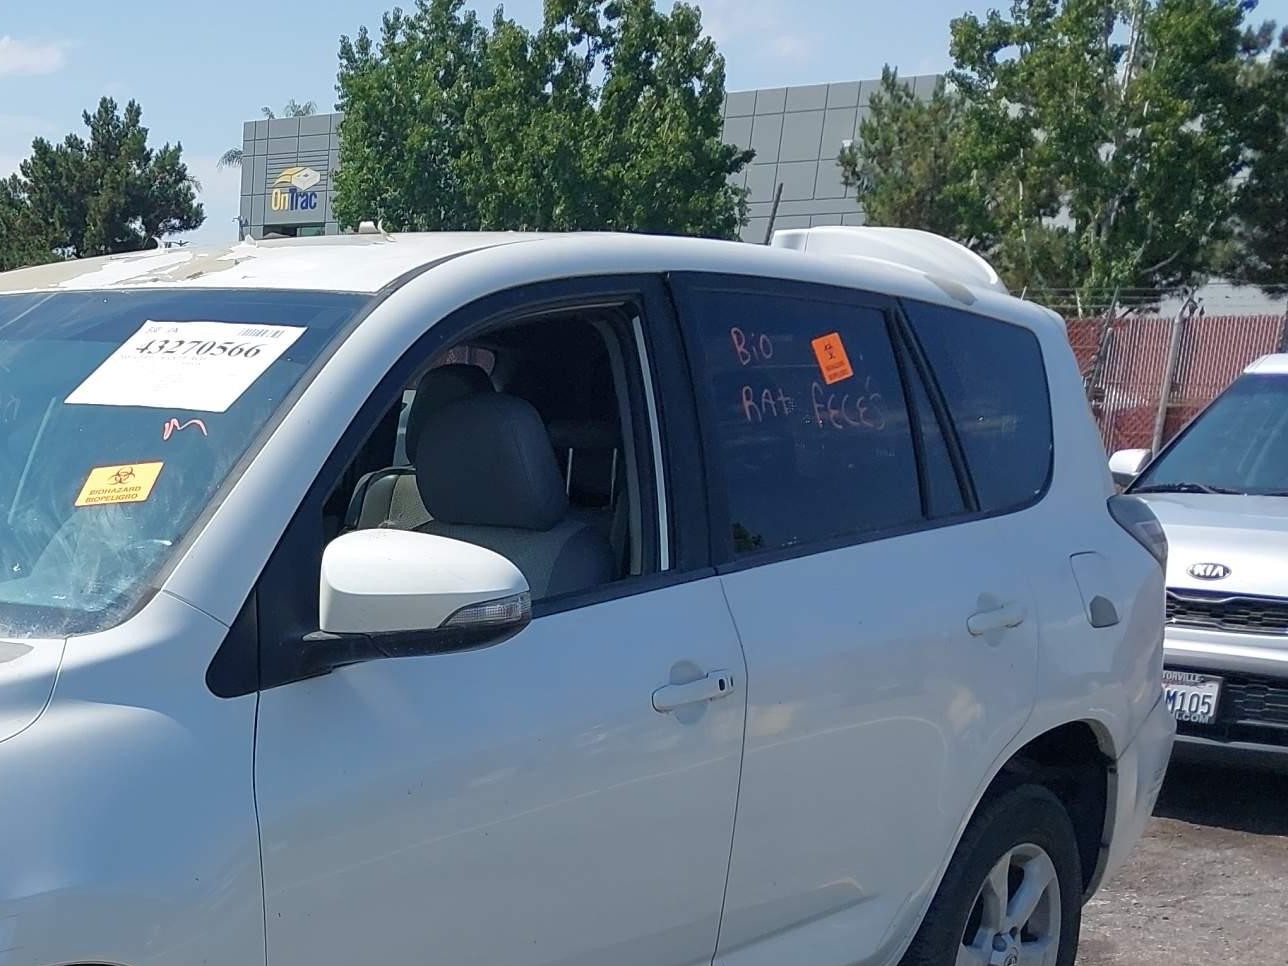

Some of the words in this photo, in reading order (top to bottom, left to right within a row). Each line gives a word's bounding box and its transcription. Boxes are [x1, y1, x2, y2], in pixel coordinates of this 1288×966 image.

[271, 188, 318, 211] OnTrac
[135, 338, 265, 360] 43270566
[89, 485, 142, 496] BIOHAZARD
[85, 493, 139, 504] BIOPELIGRO
[1192, 564, 1225, 577] KIA
